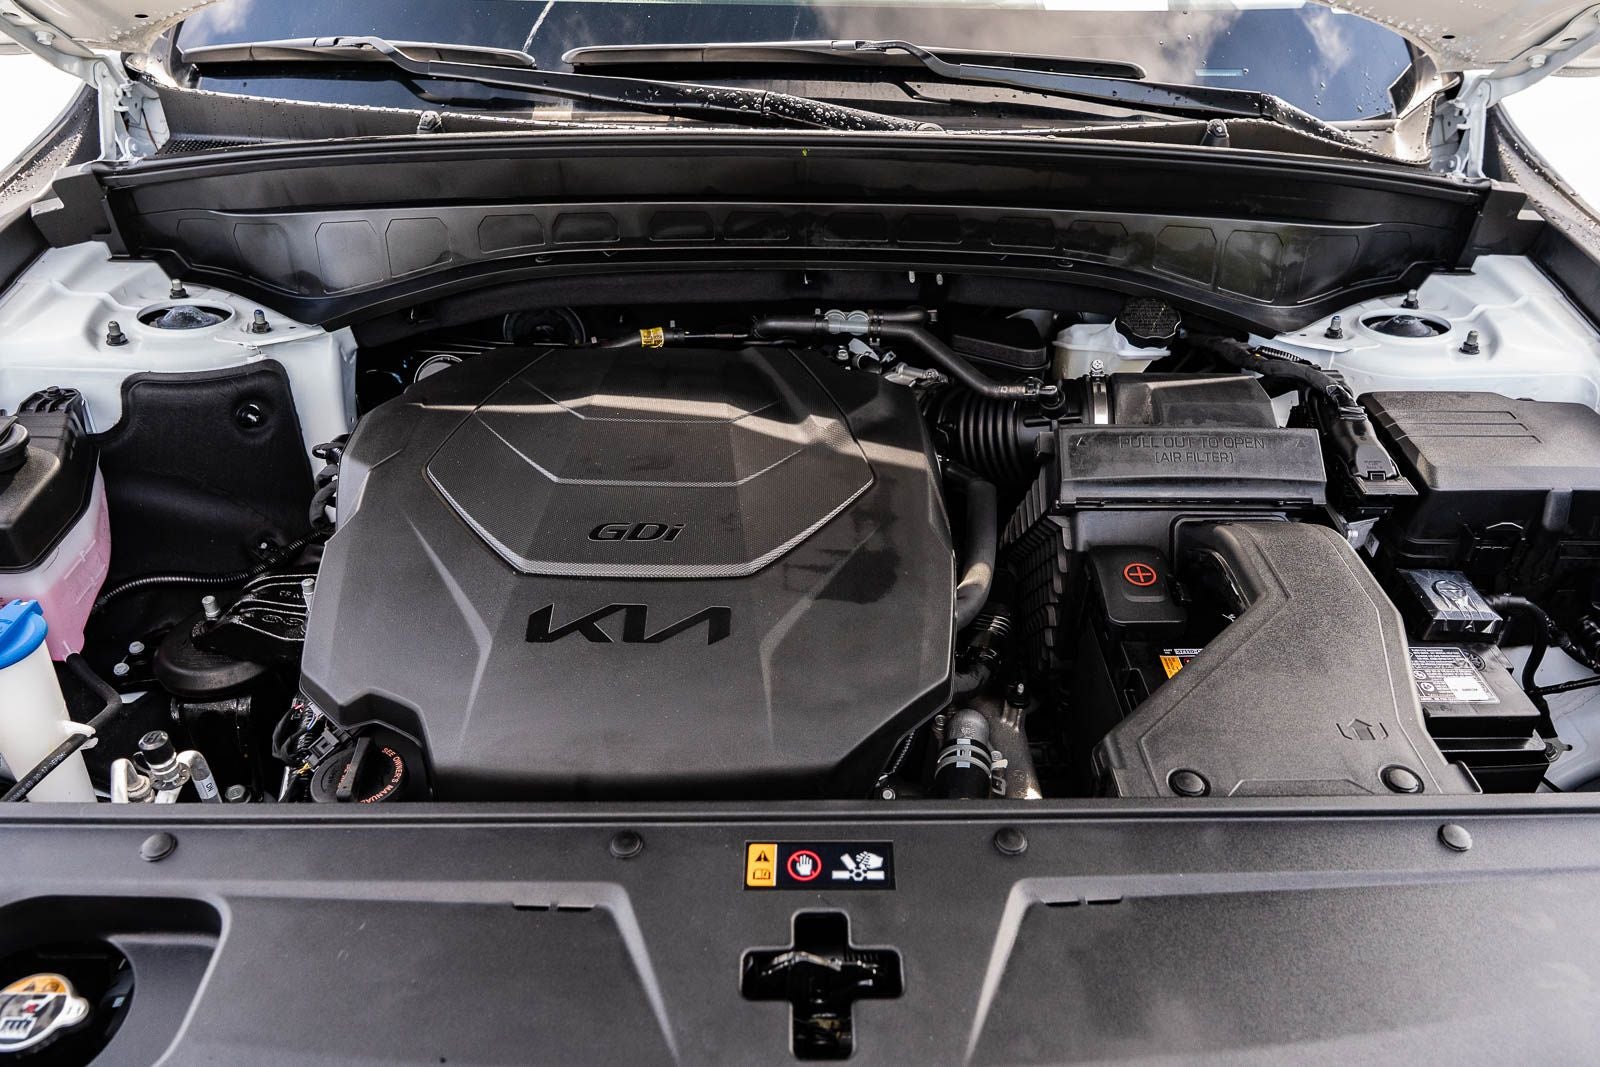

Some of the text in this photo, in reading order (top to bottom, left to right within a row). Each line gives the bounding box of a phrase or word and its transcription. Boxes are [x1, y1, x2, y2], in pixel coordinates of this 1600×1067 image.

[1119, 436, 1265, 449] PULL OUT TO OPEN
[587, 521, 686, 542] GDi
[525, 602, 732, 646] KIA
[382, 747, 396, 757] SEE
